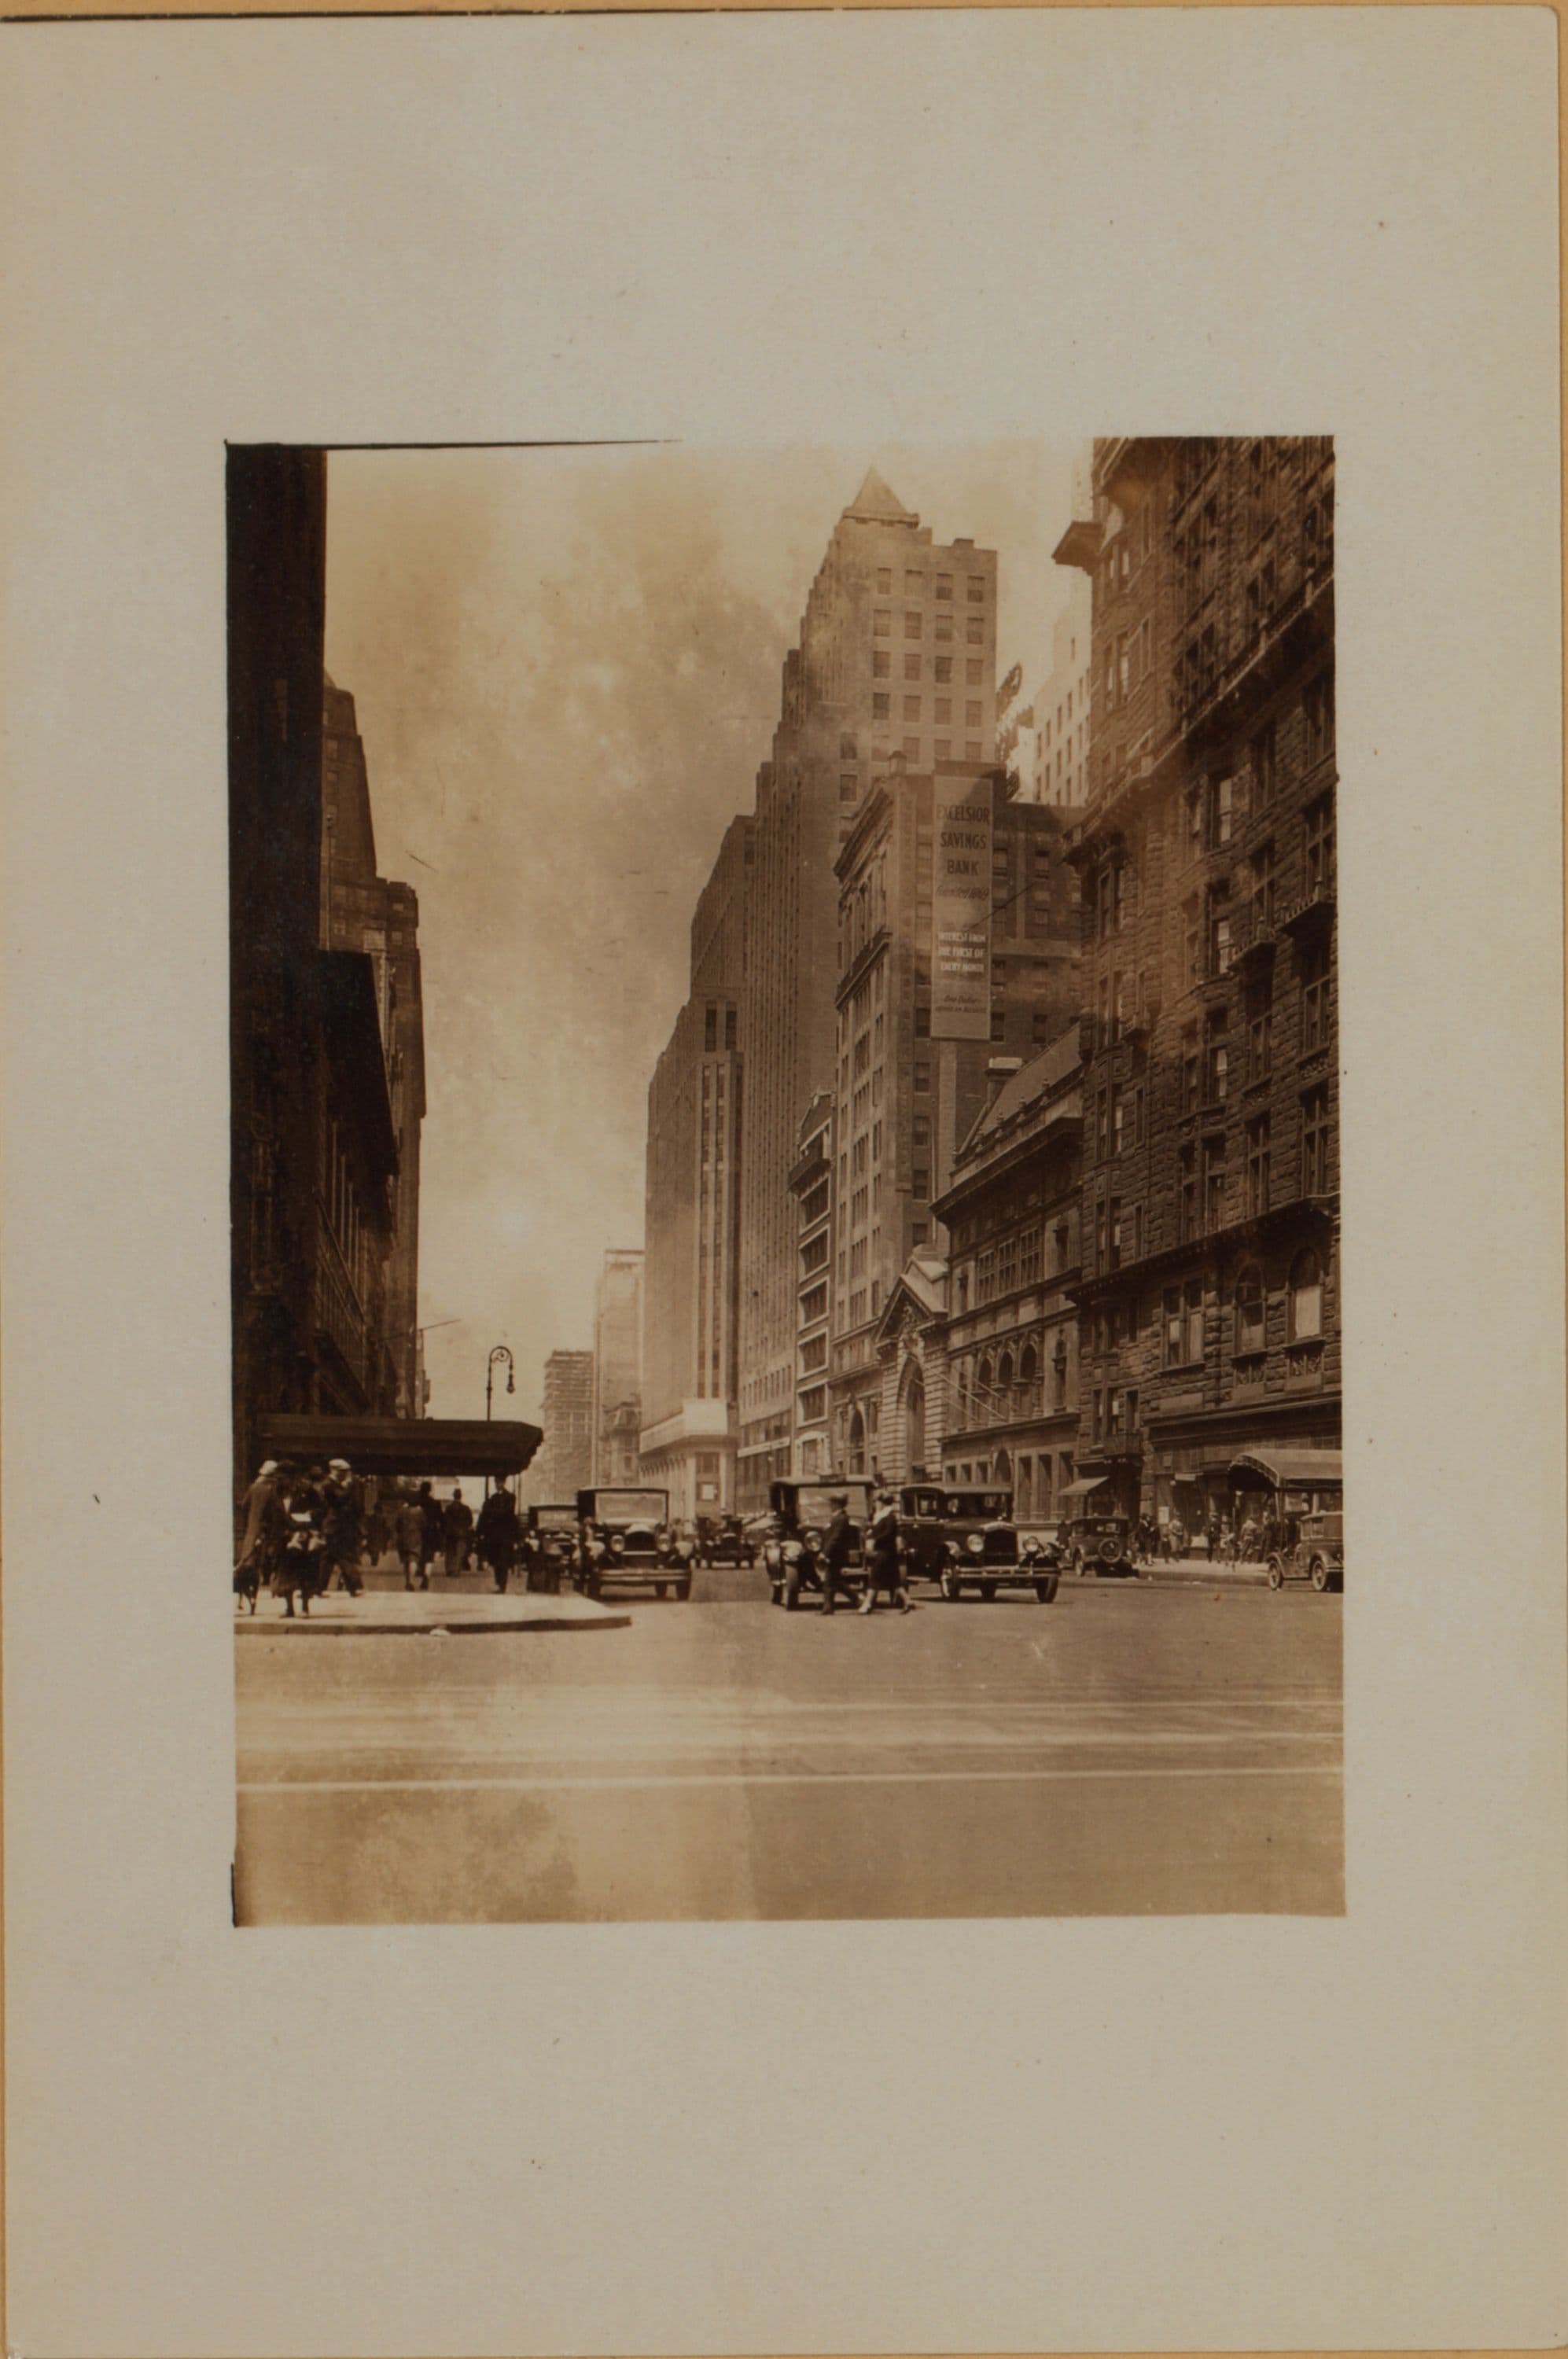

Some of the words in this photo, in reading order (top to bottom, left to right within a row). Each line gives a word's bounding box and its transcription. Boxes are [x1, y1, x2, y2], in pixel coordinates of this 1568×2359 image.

[937, 805, 990, 824] EXCELSIOR
[940, 832, 987, 850] SAVINGS
[947, 859, 980, 875] BANK
